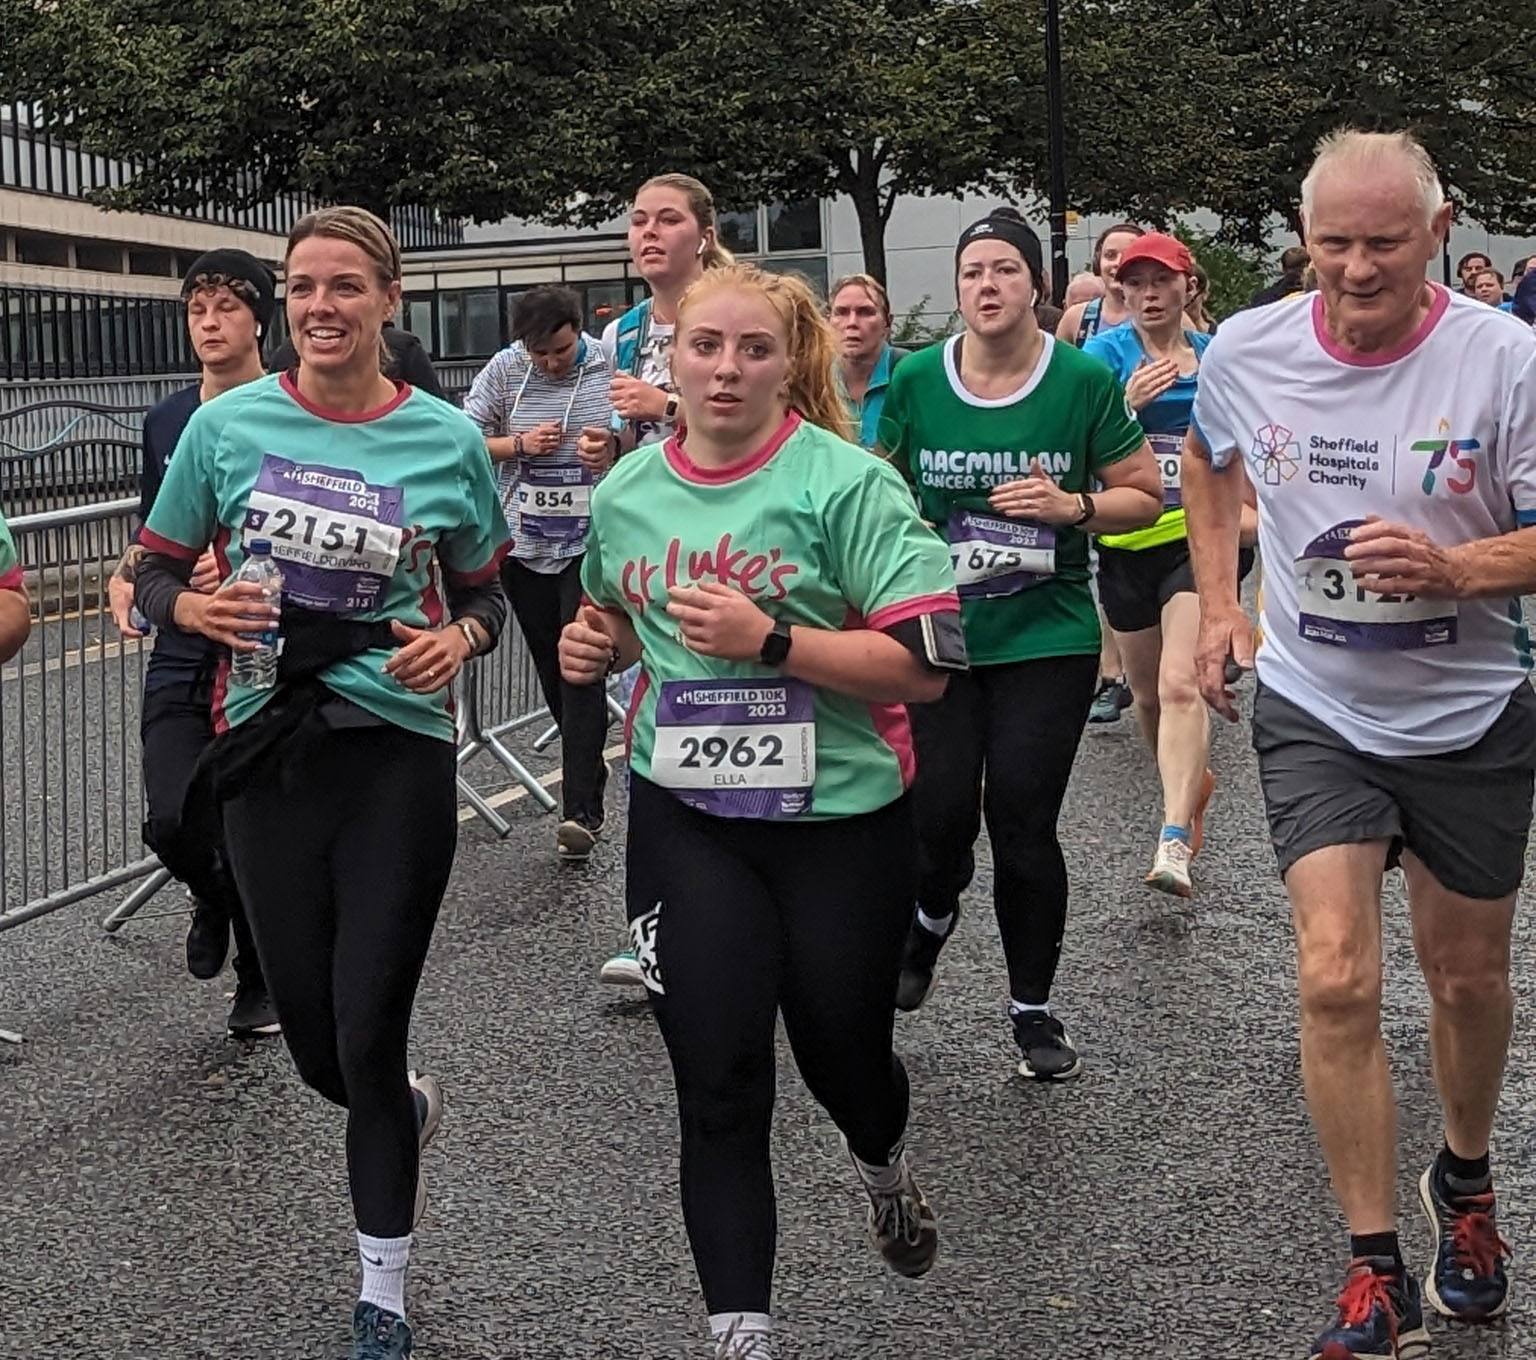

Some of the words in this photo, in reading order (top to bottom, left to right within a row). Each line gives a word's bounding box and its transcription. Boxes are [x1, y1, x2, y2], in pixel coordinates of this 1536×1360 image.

[1309, 435, 1379, 454] Sheffield
[919, 449, 1072, 474] MACMILLAN
[1309, 452, 1379, 472] Hospitals
[1410, 437, 1481, 495] 75
[922, 472, 977, 489] CANCER
[1308, 470, 1367, 491] Charity
[535, 491, 573, 507] 854
[270, 508, 368, 555] 2151
[666, 532, 799, 601] Luke's
[968, 548, 1022, 570] 675
[696, 691, 758, 702] SHEFFIELD
[760, 690, 783, 701] 10K
[748, 704, 786, 717] 2023
[678, 735, 784, 768] 2962
[714, 773, 747, 785] ELLA
